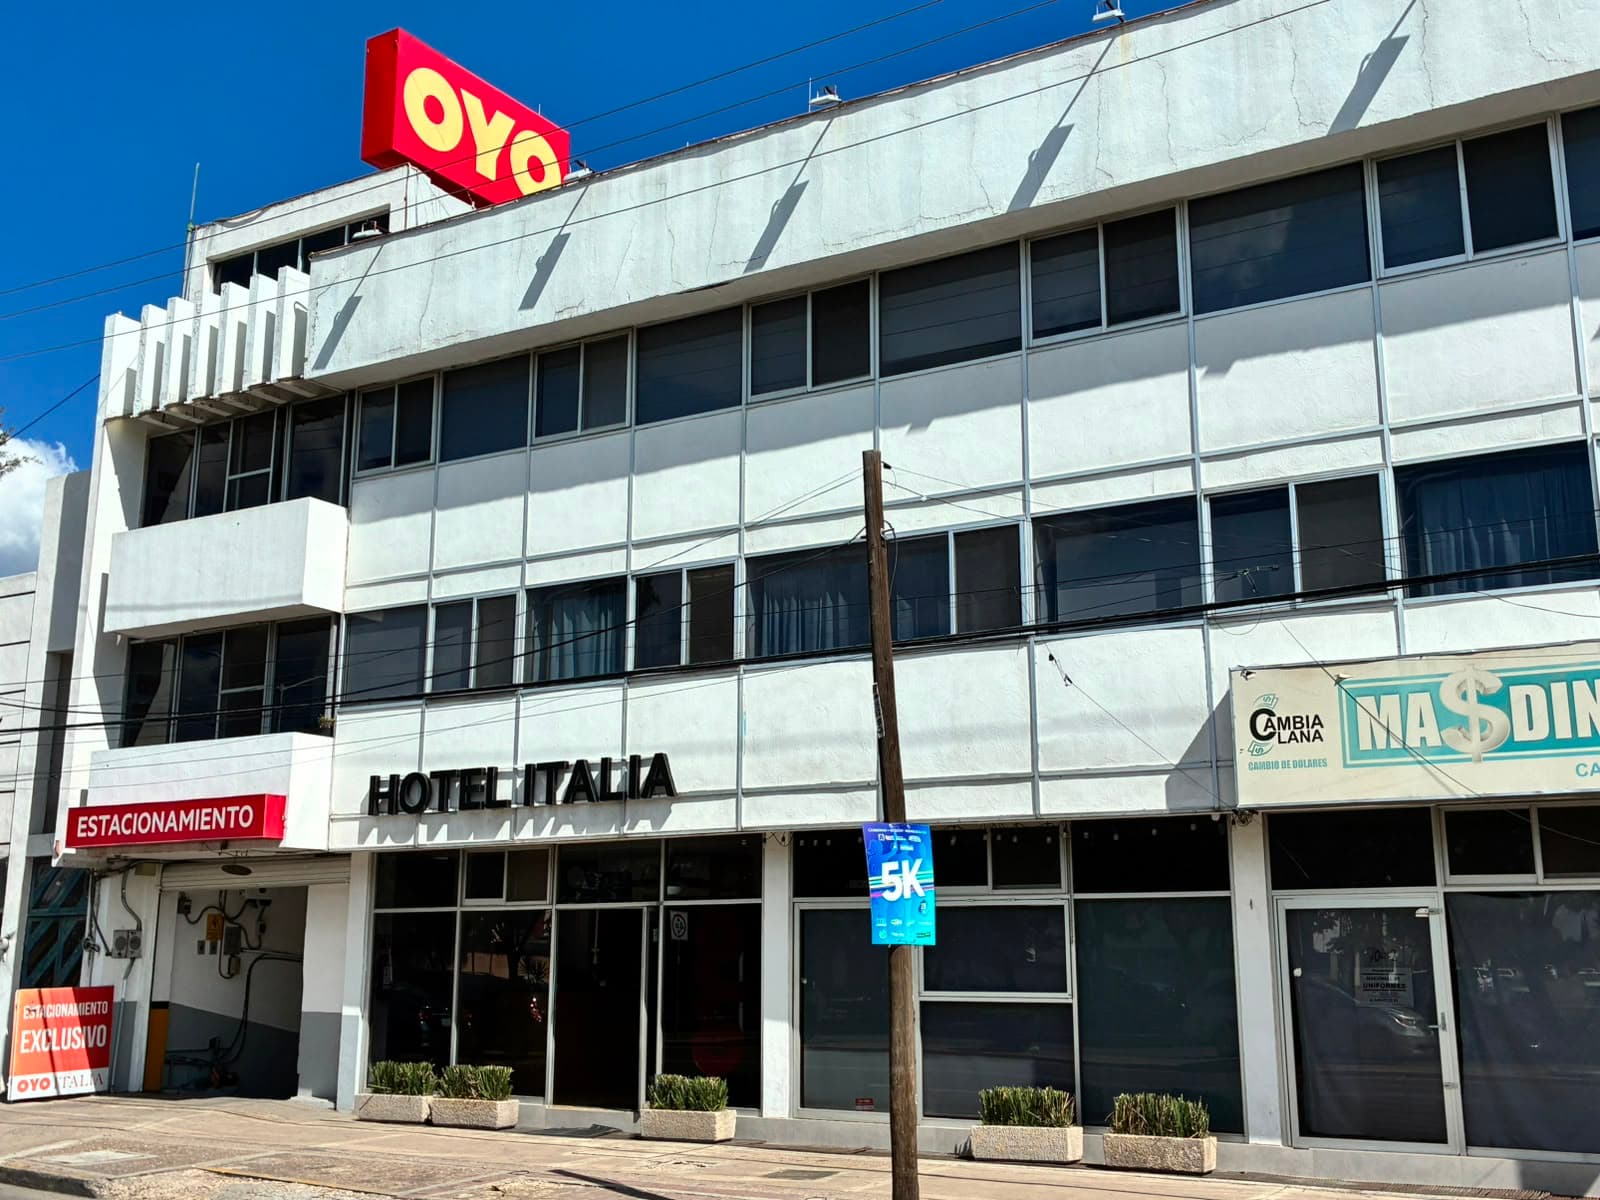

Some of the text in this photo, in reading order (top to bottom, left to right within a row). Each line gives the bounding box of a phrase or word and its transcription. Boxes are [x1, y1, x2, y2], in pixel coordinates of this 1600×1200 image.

[403, 67, 562, 196] OYO
[1249, 708, 1324, 742] CAMBIA
[1277, 729, 1324, 744] LANA
[1248, 758, 1328, 771] CAMBIO DE DOLARES
[368, 753, 677, 815] HOTEL ITALIA
[77, 805, 254, 838] ESTACIONAMIENTO
[881, 858, 926, 902] 5K
[23, 1001, 109, 1019] ESTACIONAMIENTO
[20, 1025, 107, 1054] EXCLUSIVO
[17, 1077, 51, 1093] OYO
